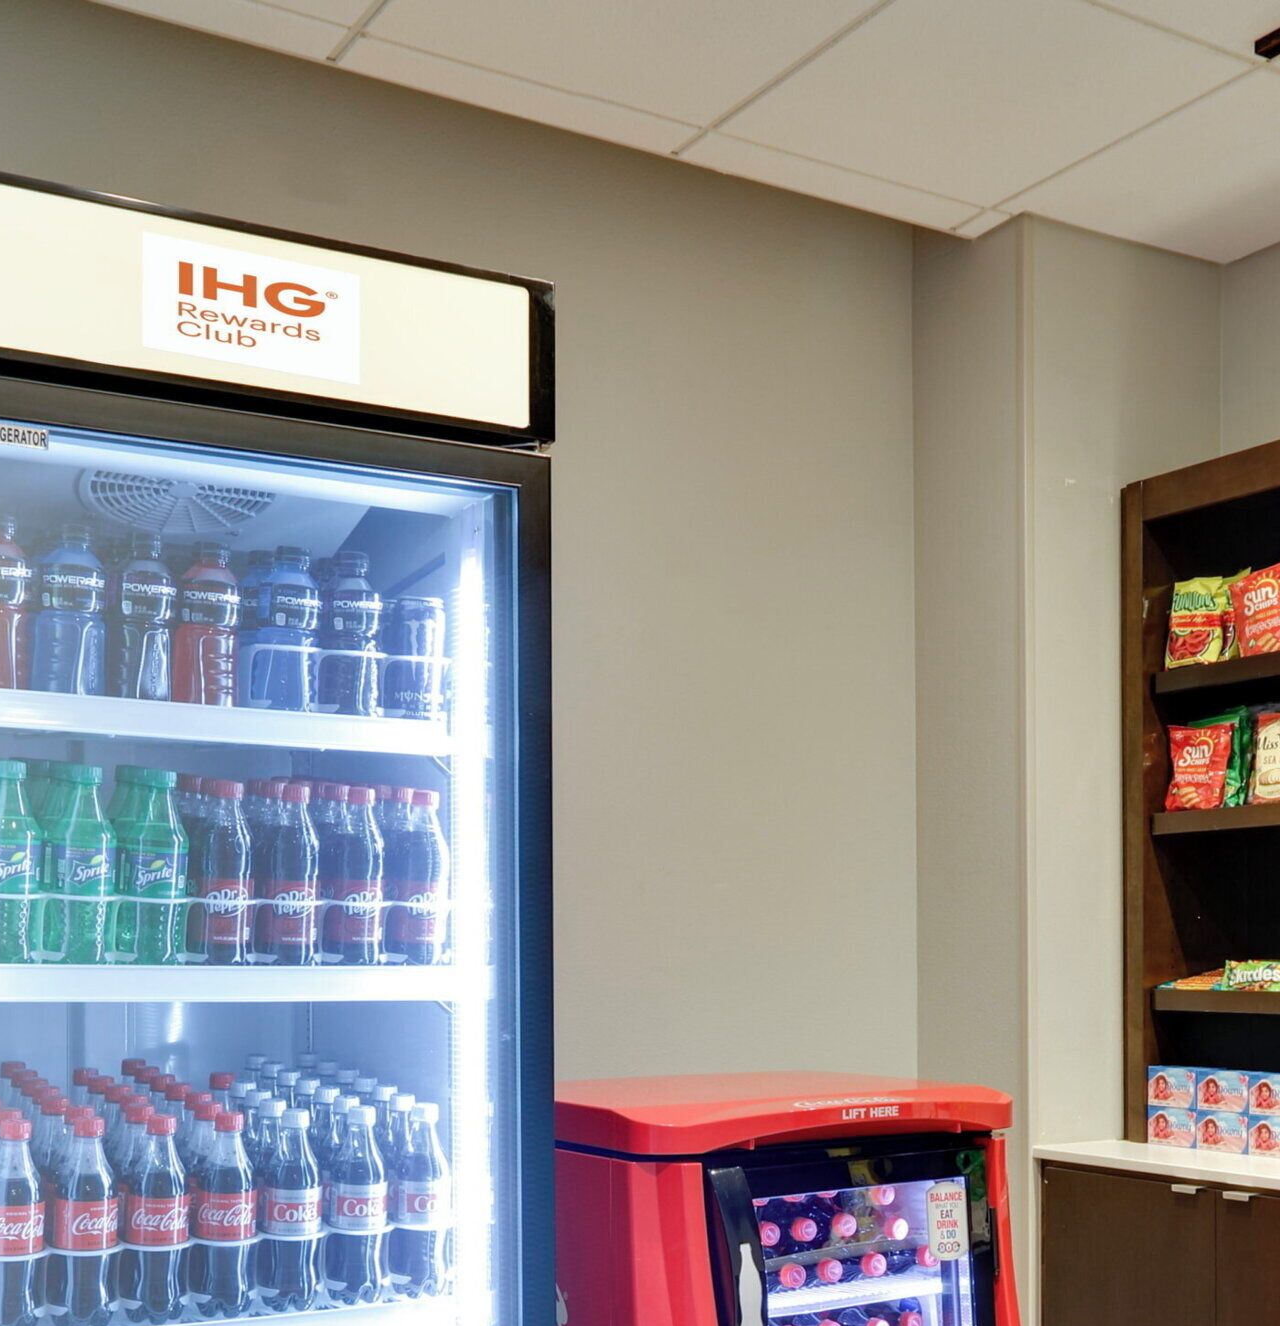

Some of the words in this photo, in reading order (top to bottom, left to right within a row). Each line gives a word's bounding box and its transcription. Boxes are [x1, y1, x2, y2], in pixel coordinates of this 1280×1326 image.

[178, 261, 326, 318] IHG
[177, 301, 321, 342] Rewards
[176, 320, 257, 349] Club
[43, 574, 106, 589] POWERADE
[1244, 580, 1279, 616] Sun
[1179, 739, 1212, 767] Sun
[74, 861, 109, 881] Sprite
[137, 865, 173, 885] Sprite
[842, 1108, 867, 1120] LIFT
[870, 1106, 900, 1118] HERE
[929, 1191, 962, 1203] BALANCE
[273, 1204, 318, 1222] Coke
[940, 1209, 953, 1219] EAT
[937, 1219, 959, 1230] DRINK
[946, 1229, 957, 1239] DO
